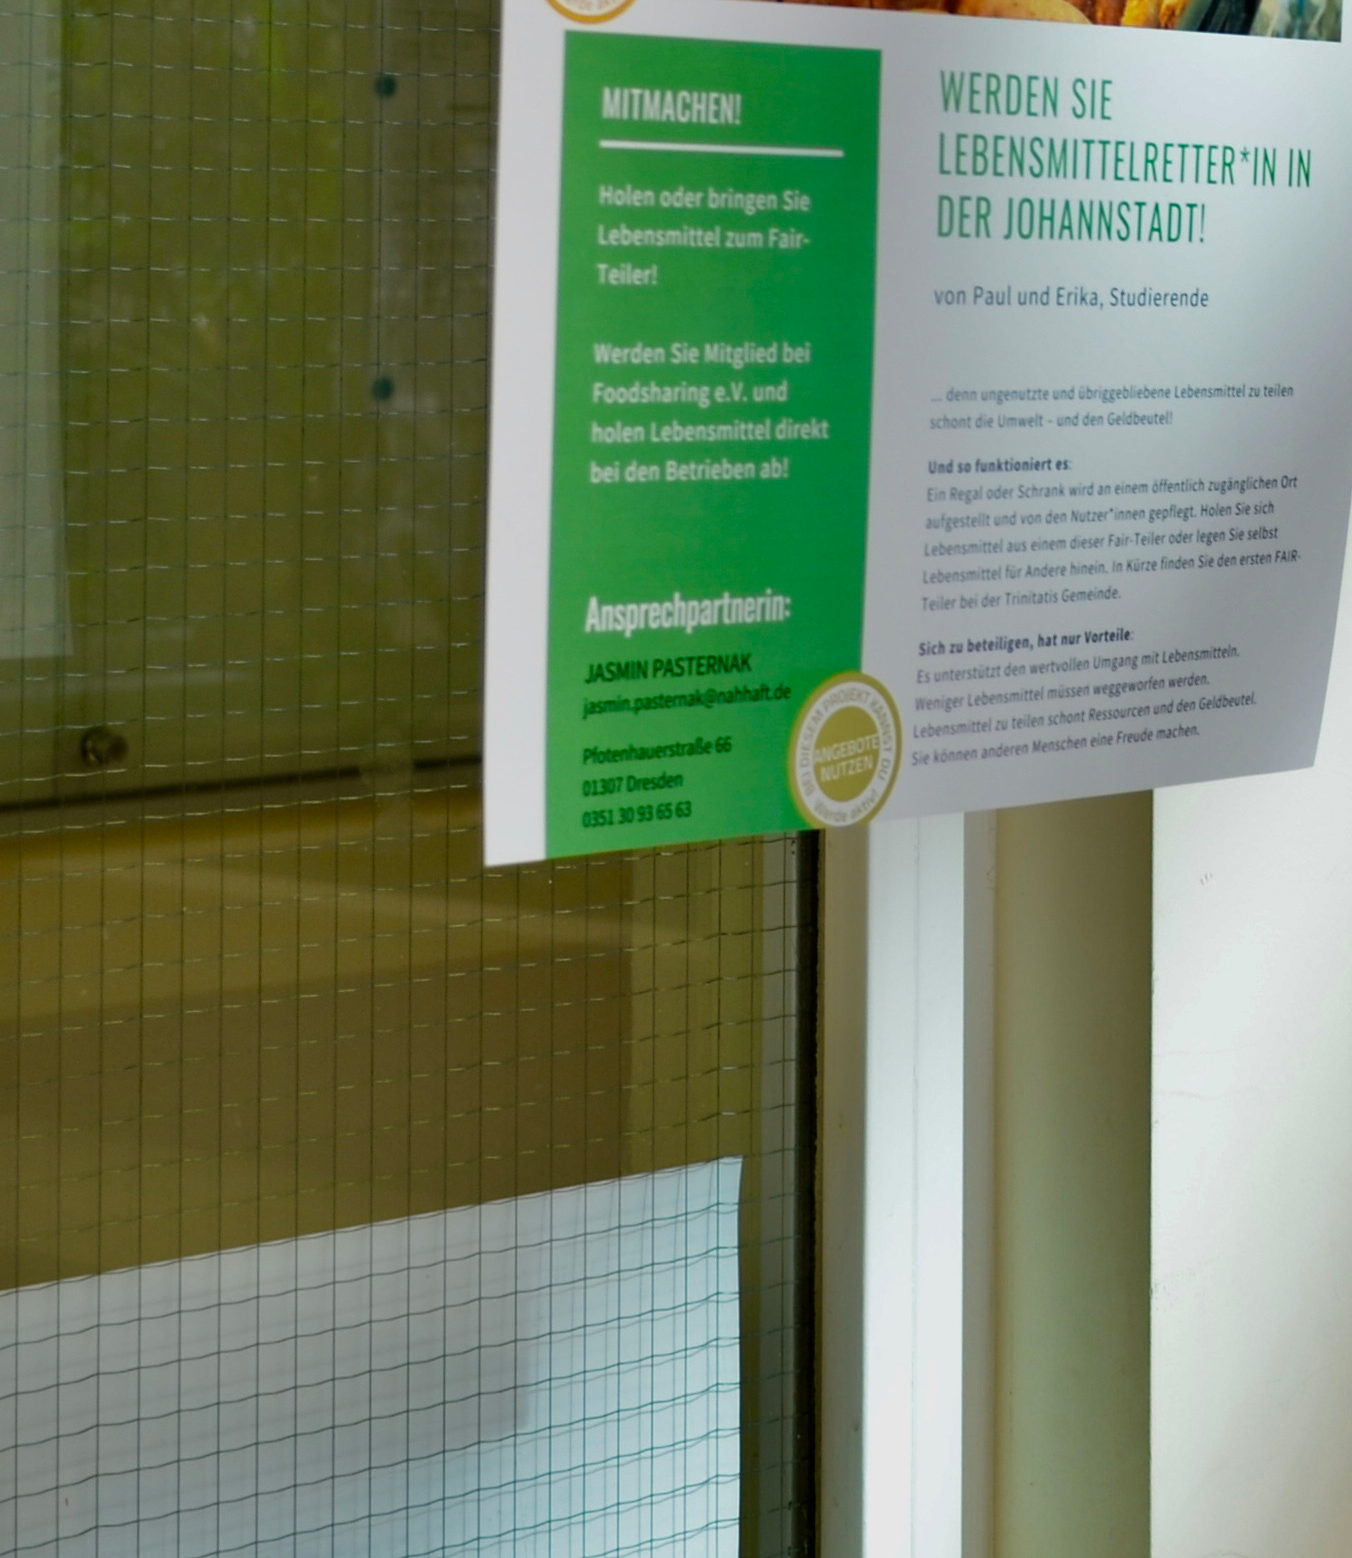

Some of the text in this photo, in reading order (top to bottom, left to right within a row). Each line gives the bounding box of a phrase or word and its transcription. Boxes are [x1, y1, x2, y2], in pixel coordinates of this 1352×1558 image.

[602, 87, 742, 125] MITMACHEN!
[940, 70, 1112, 120] WERDEN SIE
[1289, 149, 1311, 187] IN
[599, 185, 810, 214] Holen oder bringen Sie
[938, 195, 1206, 242] DER JOHANNSTADT!
[598, 225, 810, 250] Lebensmittel zum Fair-
[597, 264, 658, 285] Teiler!
[934, 285, 1208, 309] von Paul und Erika, Studierende
[593, 341, 810, 368] Werden Sie Mitglied bei
[593, 381, 788, 408] Foodsharing e.V. und
[946, 387, 977, 403] denn
[981, 387, 1049, 404] ungenutzte
[1053, 386, 1075, 401] und
[1078, 385, 1170, 404] übriggebliebene
[1174, 385, 1245, 399] Lebensmittel
[1248, 387, 1260, 397] zu
[1263, 384, 1293, 397] teilen
[591, 418, 829, 444] holen Lebensmittel direkt
[590, 457, 789, 483] bei den Betrieben ab!
[928, 458, 1072, 474] Und so funktioniert es:
[585, 587, 791, 638] Ansprechpartnerin:
[918, 628, 1133, 657] Sich zu beteiligen, hat nur Vorteile:
[585, 652, 752, 684] JASMIN PASTERNAK
[583, 682, 791, 720] jasmin.pasternak@nahhaft.de
[583, 736, 732, 766] Pfotenhauerstraße 66
[816, 733, 879, 763] ANGEBOTE
[820, 754, 874, 783] NUTZEN
[583, 773, 683, 797] 01307 Dresden
[583, 801, 691, 828] 0351 30 93 65 63
